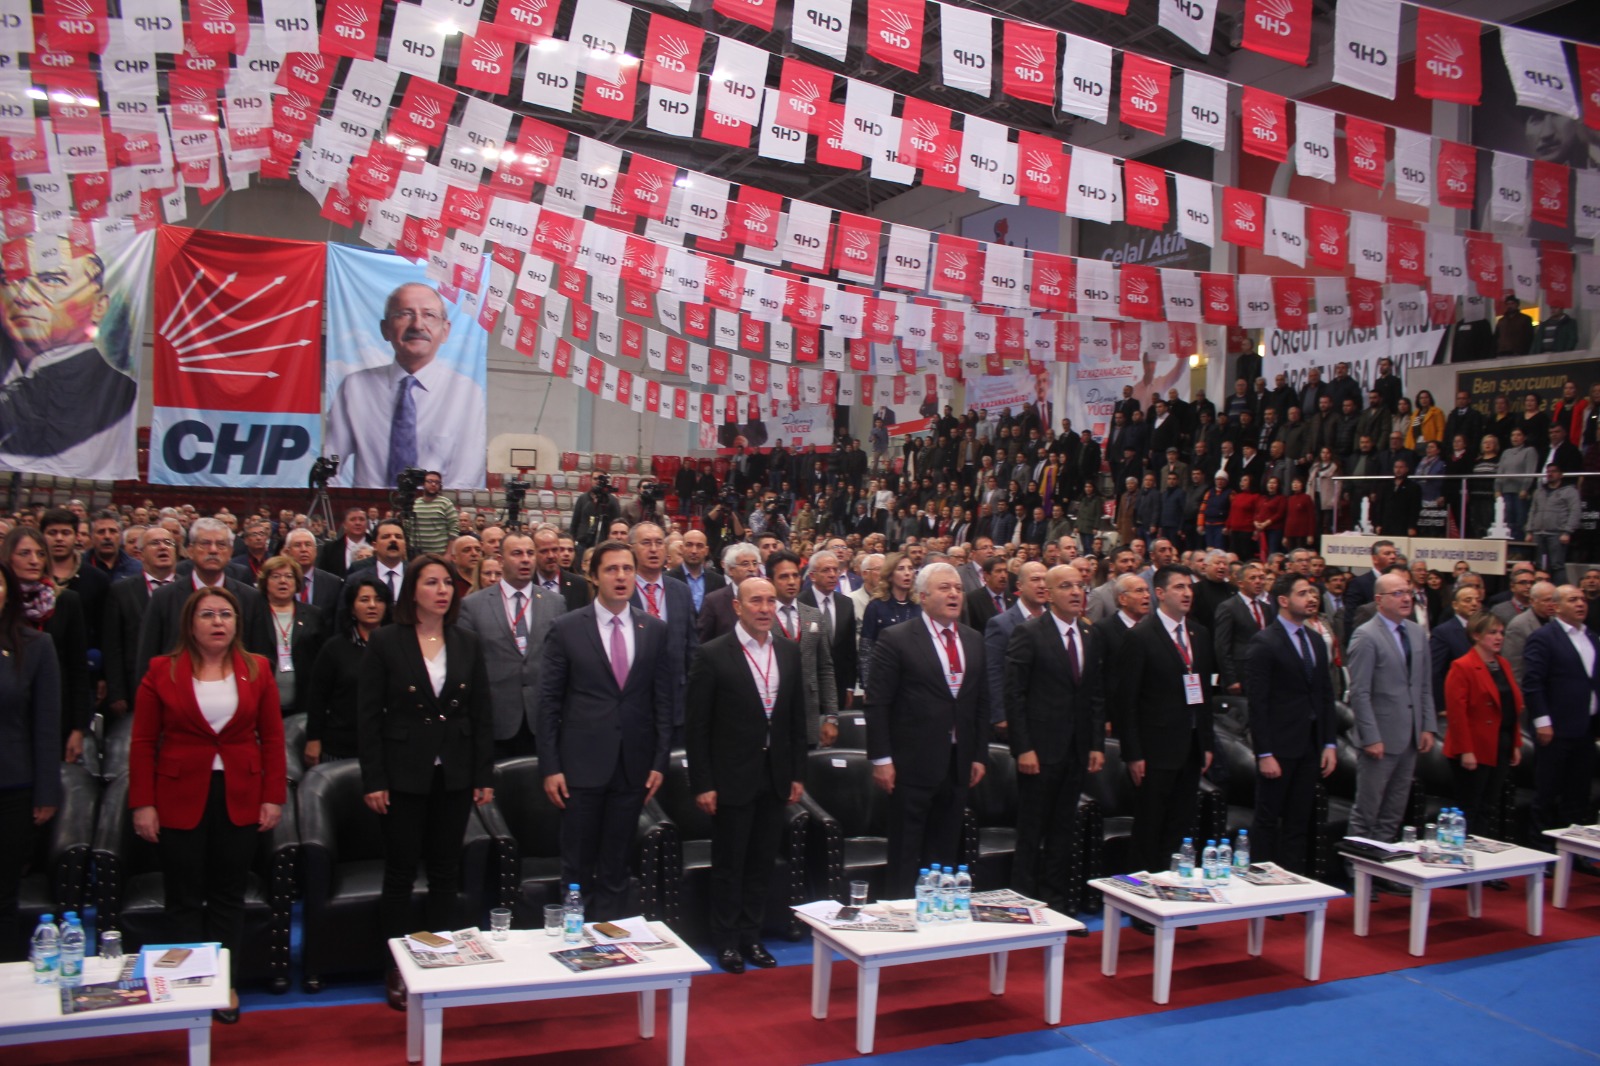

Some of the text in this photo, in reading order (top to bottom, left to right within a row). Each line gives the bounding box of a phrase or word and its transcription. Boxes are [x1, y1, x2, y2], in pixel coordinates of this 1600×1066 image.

[41, 54, 74, 67] CHP
[114, 59, 149, 73] CHP
[186, 58, 216, 70] CHP
[249, 60, 280, 73] CHP
[181, 134, 207, 145] CHP
[11, 150, 37, 161] CHP
[68, 145, 96, 157] CHP
[1472, 377, 1496, 394] Ben
[163, 419, 310, 475] CHP
